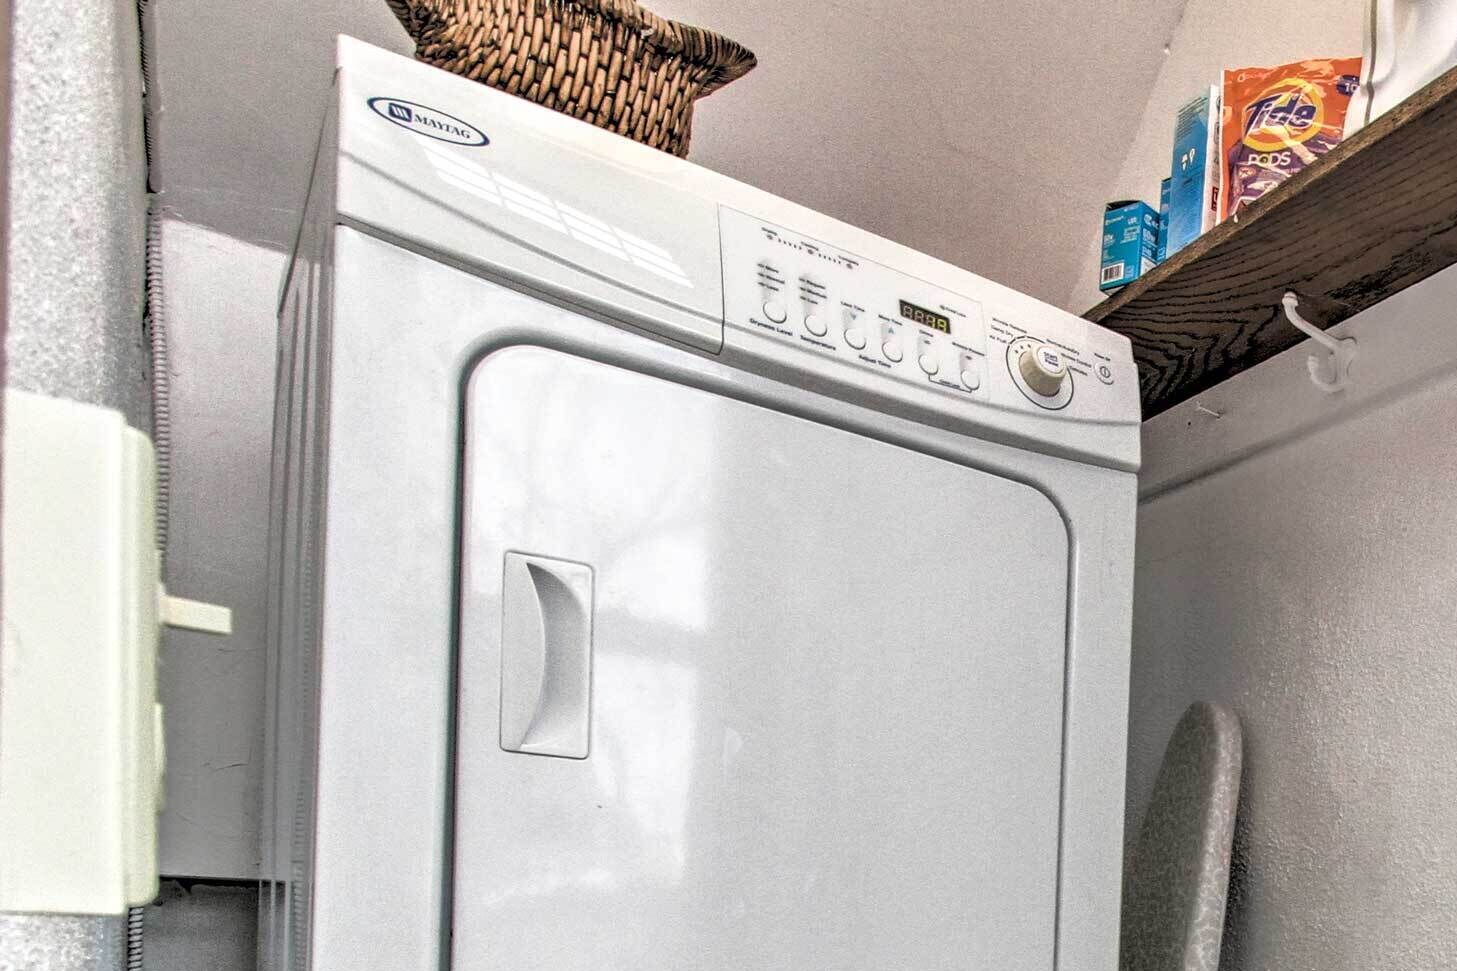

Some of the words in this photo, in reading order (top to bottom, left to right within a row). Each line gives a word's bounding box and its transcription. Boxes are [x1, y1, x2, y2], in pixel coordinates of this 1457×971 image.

[1244, 91, 1318, 137] Tide
[414, 113, 471, 139] MAYTAG
[1247, 151, 1292, 167] PODS
[776, 326, 793, 336] Level
[799, 334, 836, 350] Temperature
